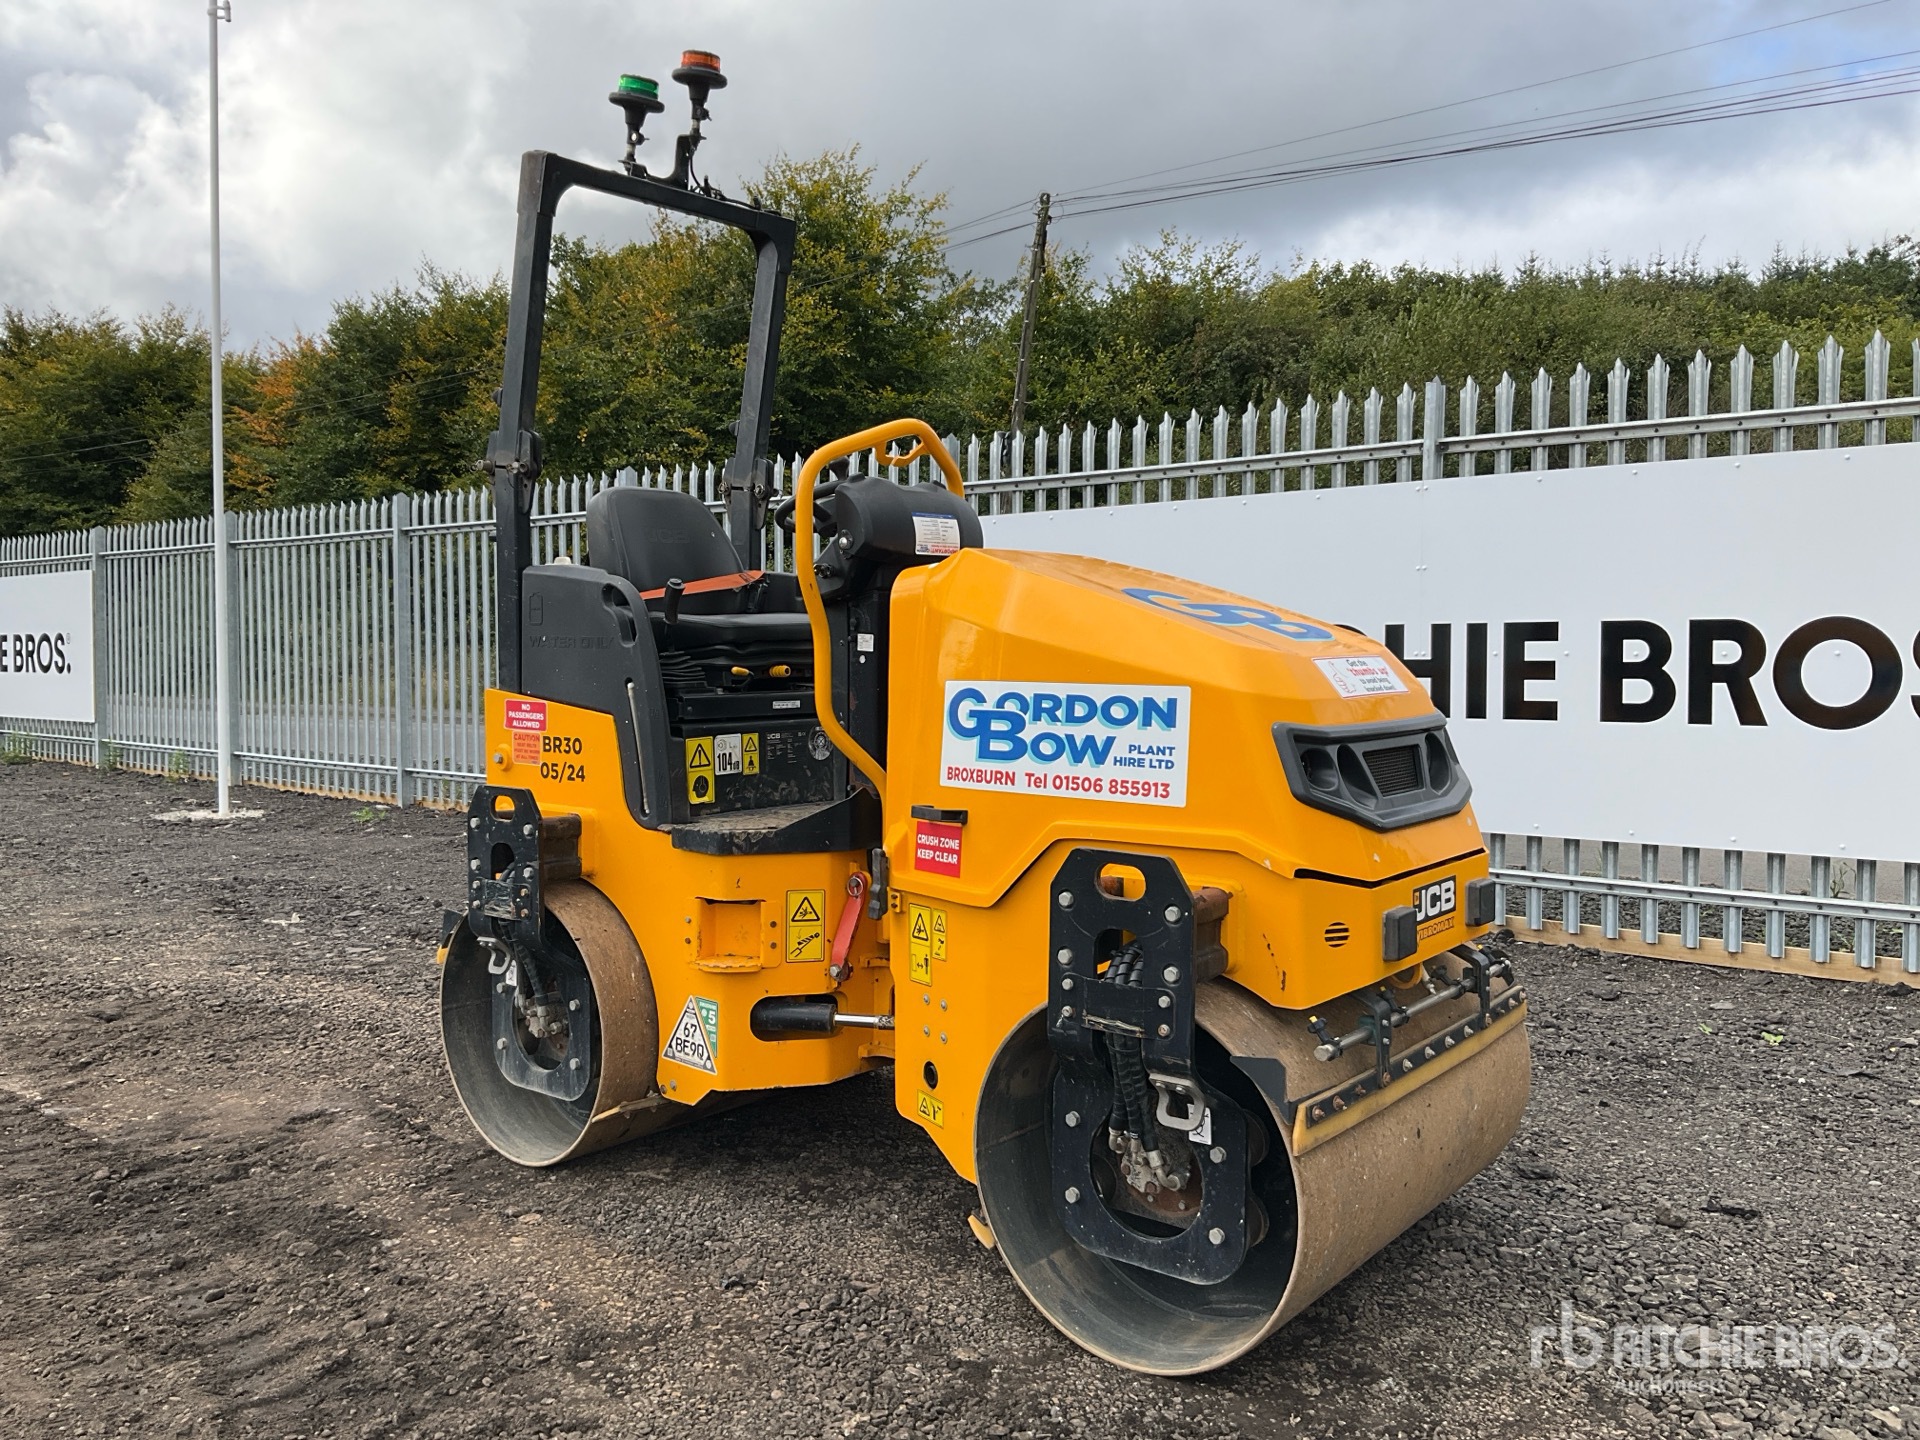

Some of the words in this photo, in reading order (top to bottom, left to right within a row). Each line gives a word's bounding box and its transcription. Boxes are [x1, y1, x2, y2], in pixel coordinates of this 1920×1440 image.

[529, 636, 576, 648] WATER
[581, 636, 614, 649] ONLY
[13, 633, 71, 674] BROS.
[1600, 615, 1920, 730] BRO
[508, 711, 544, 720] PASSENGERS
[947, 688, 1177, 738] GORDON
[512, 720, 540, 728] ALLOWED
[514, 733, 540, 742] CAUTION
[543, 736, 582, 755] BR30
[969, 709, 1117, 767] BOW
[1128, 744, 1175, 757] PLANT
[1113, 756, 1145, 768] HIRE
[1149, 758, 1175, 770] LTD
[540, 762, 585, 783] 05/24
[947, 766, 1016, 786] BROXBURN
[1025, 772, 1047, 789] Tel
[1052, 774, 1104, 793] 01506
[1108, 778, 1171, 799] 855913
[917, 834, 939, 846] CRUSH
[940, 838, 959, 850] ZONE
[917, 848, 934, 859] KEEP
[935, 851, 958, 864] CLEAR
[1416, 880, 1455, 921] JCB
